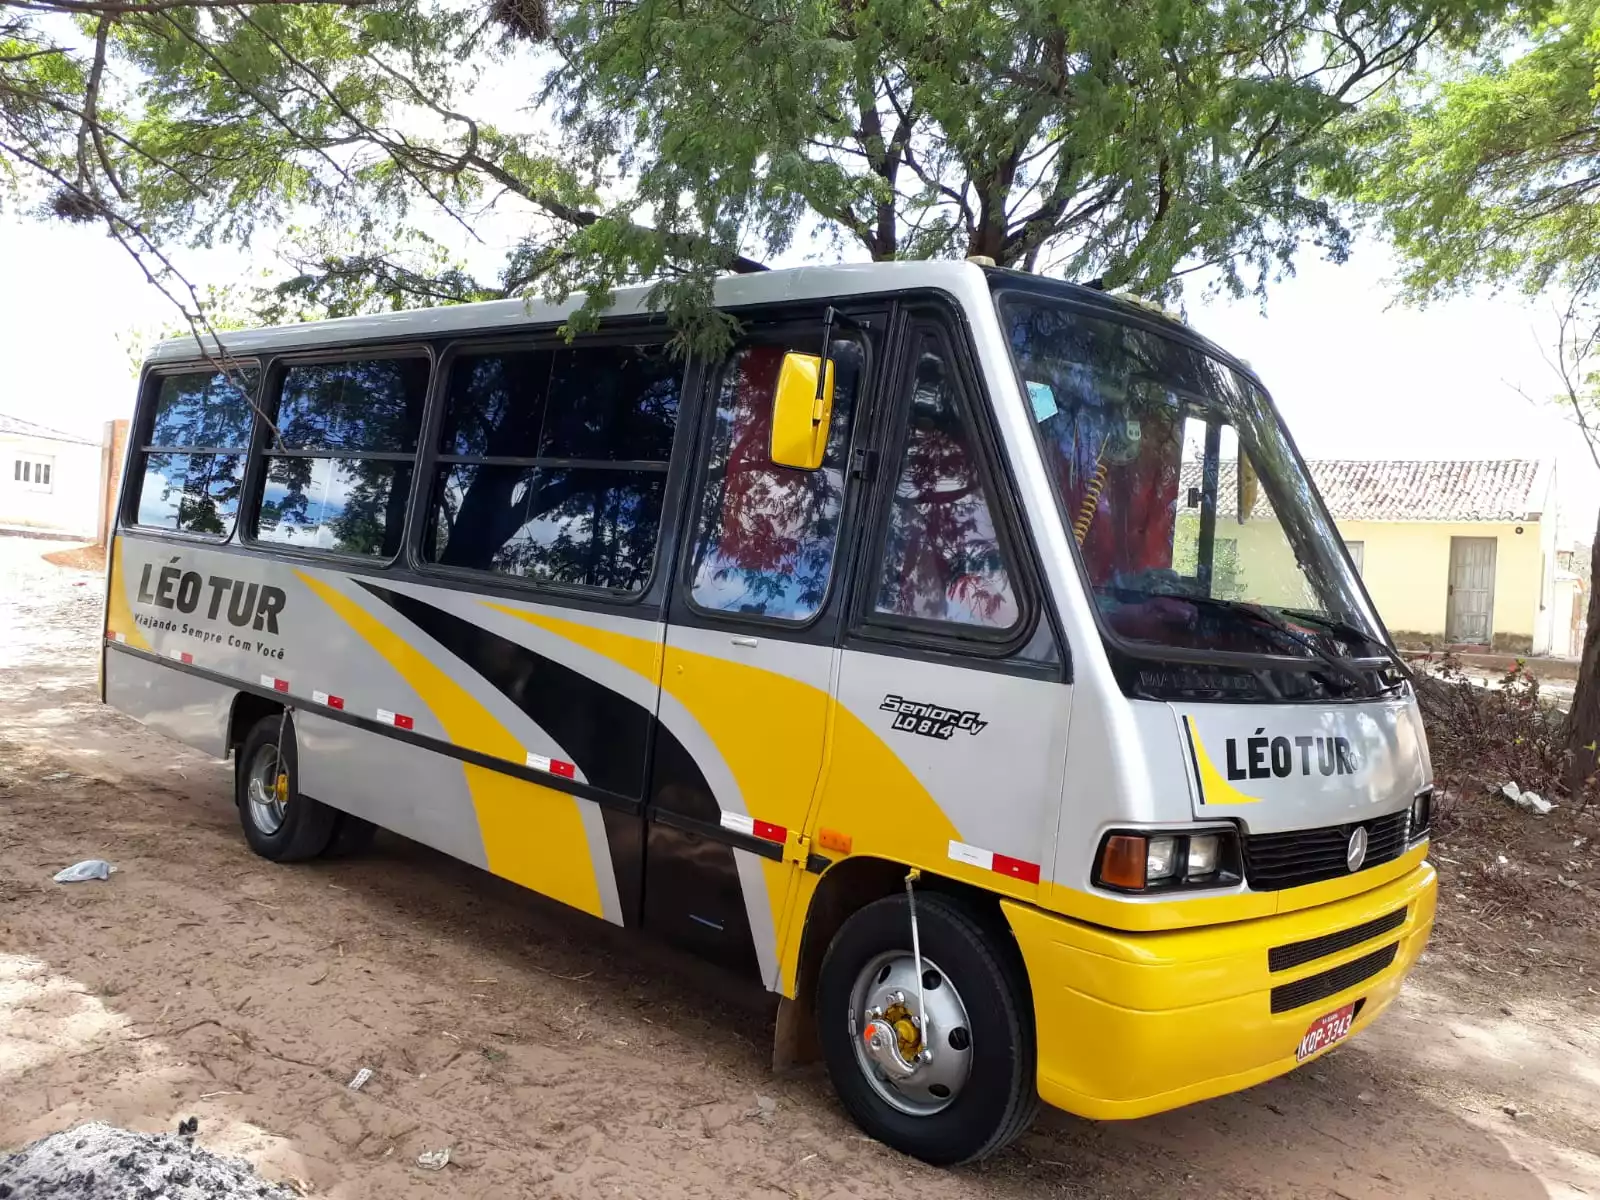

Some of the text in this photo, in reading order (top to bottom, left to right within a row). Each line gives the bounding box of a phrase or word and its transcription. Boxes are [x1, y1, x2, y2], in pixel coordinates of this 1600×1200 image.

[137, 556, 287, 635] LÉO TUR
[135, 613, 285, 660] Viajando Sempre Com Você
[916, 719, 954, 740] 814
[1225, 728, 1353, 781] LÉO TUR
